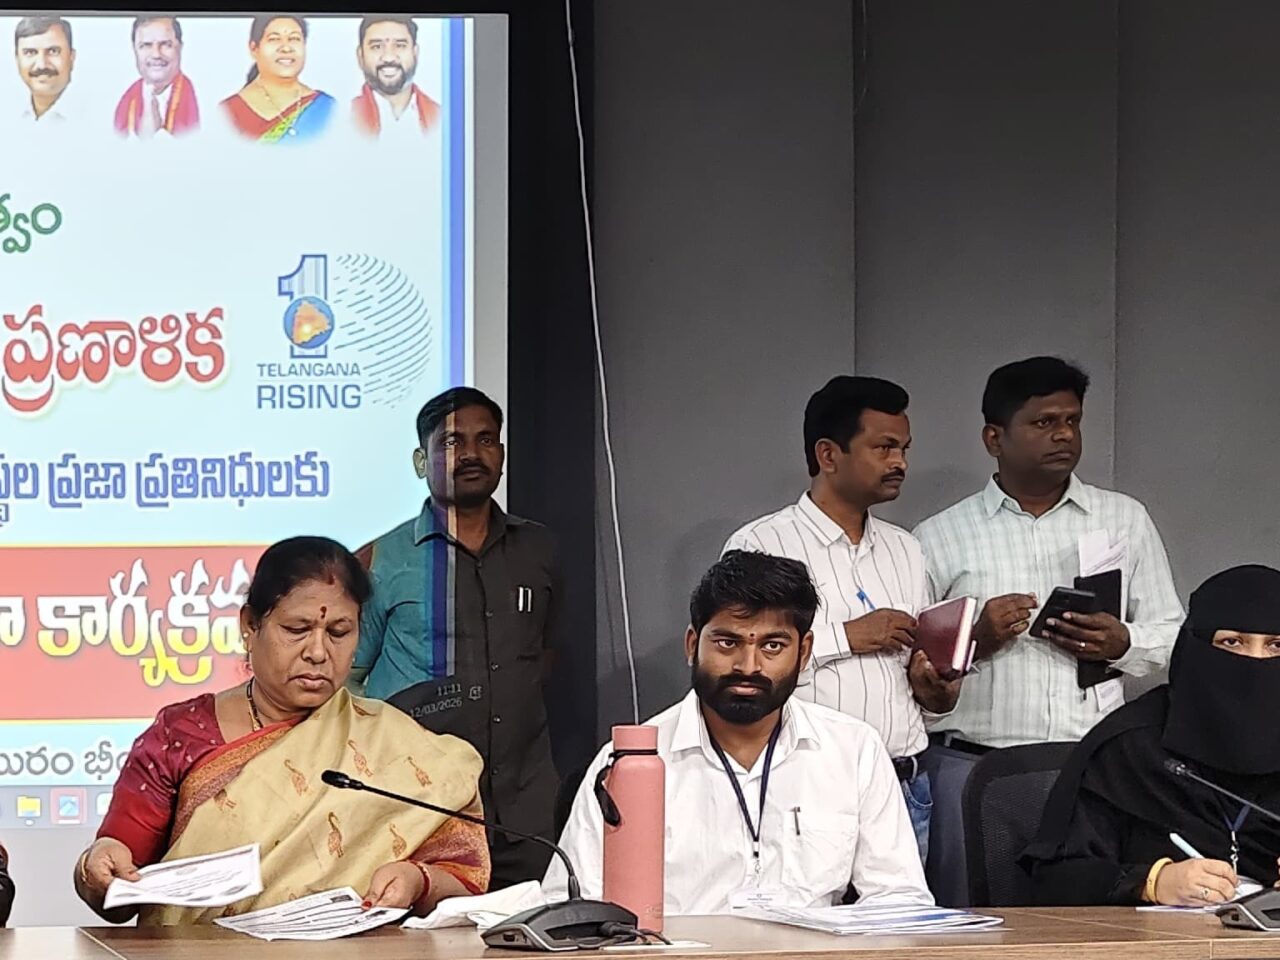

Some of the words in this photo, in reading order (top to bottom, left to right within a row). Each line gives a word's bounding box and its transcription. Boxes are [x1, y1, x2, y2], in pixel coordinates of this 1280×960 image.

[2, 304, 226, 412] ప్రణాళిక
[256, 362, 362, 378] TELANGANA
[256, 384, 362, 410] RISING
[47, 452, 127, 509] ప్రజా
[135, 450, 331, 509] ప్రతినిధులకు
[36, 558, 250, 687] కార్యక్రమ
